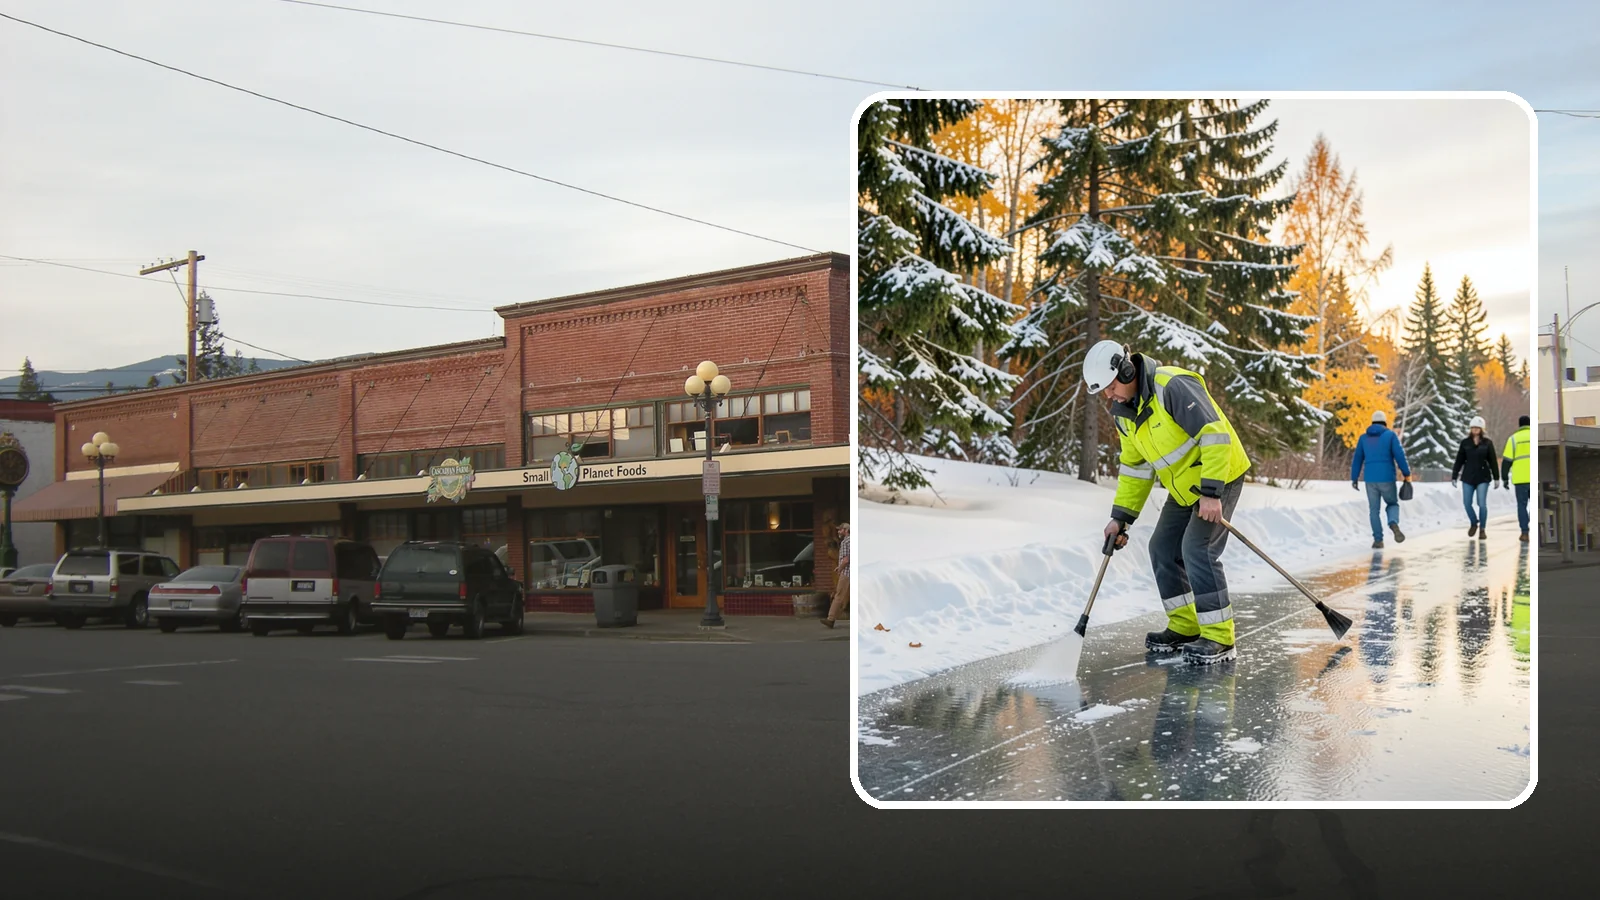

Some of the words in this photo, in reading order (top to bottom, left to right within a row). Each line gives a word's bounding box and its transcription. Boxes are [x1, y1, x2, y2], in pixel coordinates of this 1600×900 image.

[523, 471, 549, 483] Small
[583, 467, 614, 479] Planet
[617, 464, 647, 477] Foods
